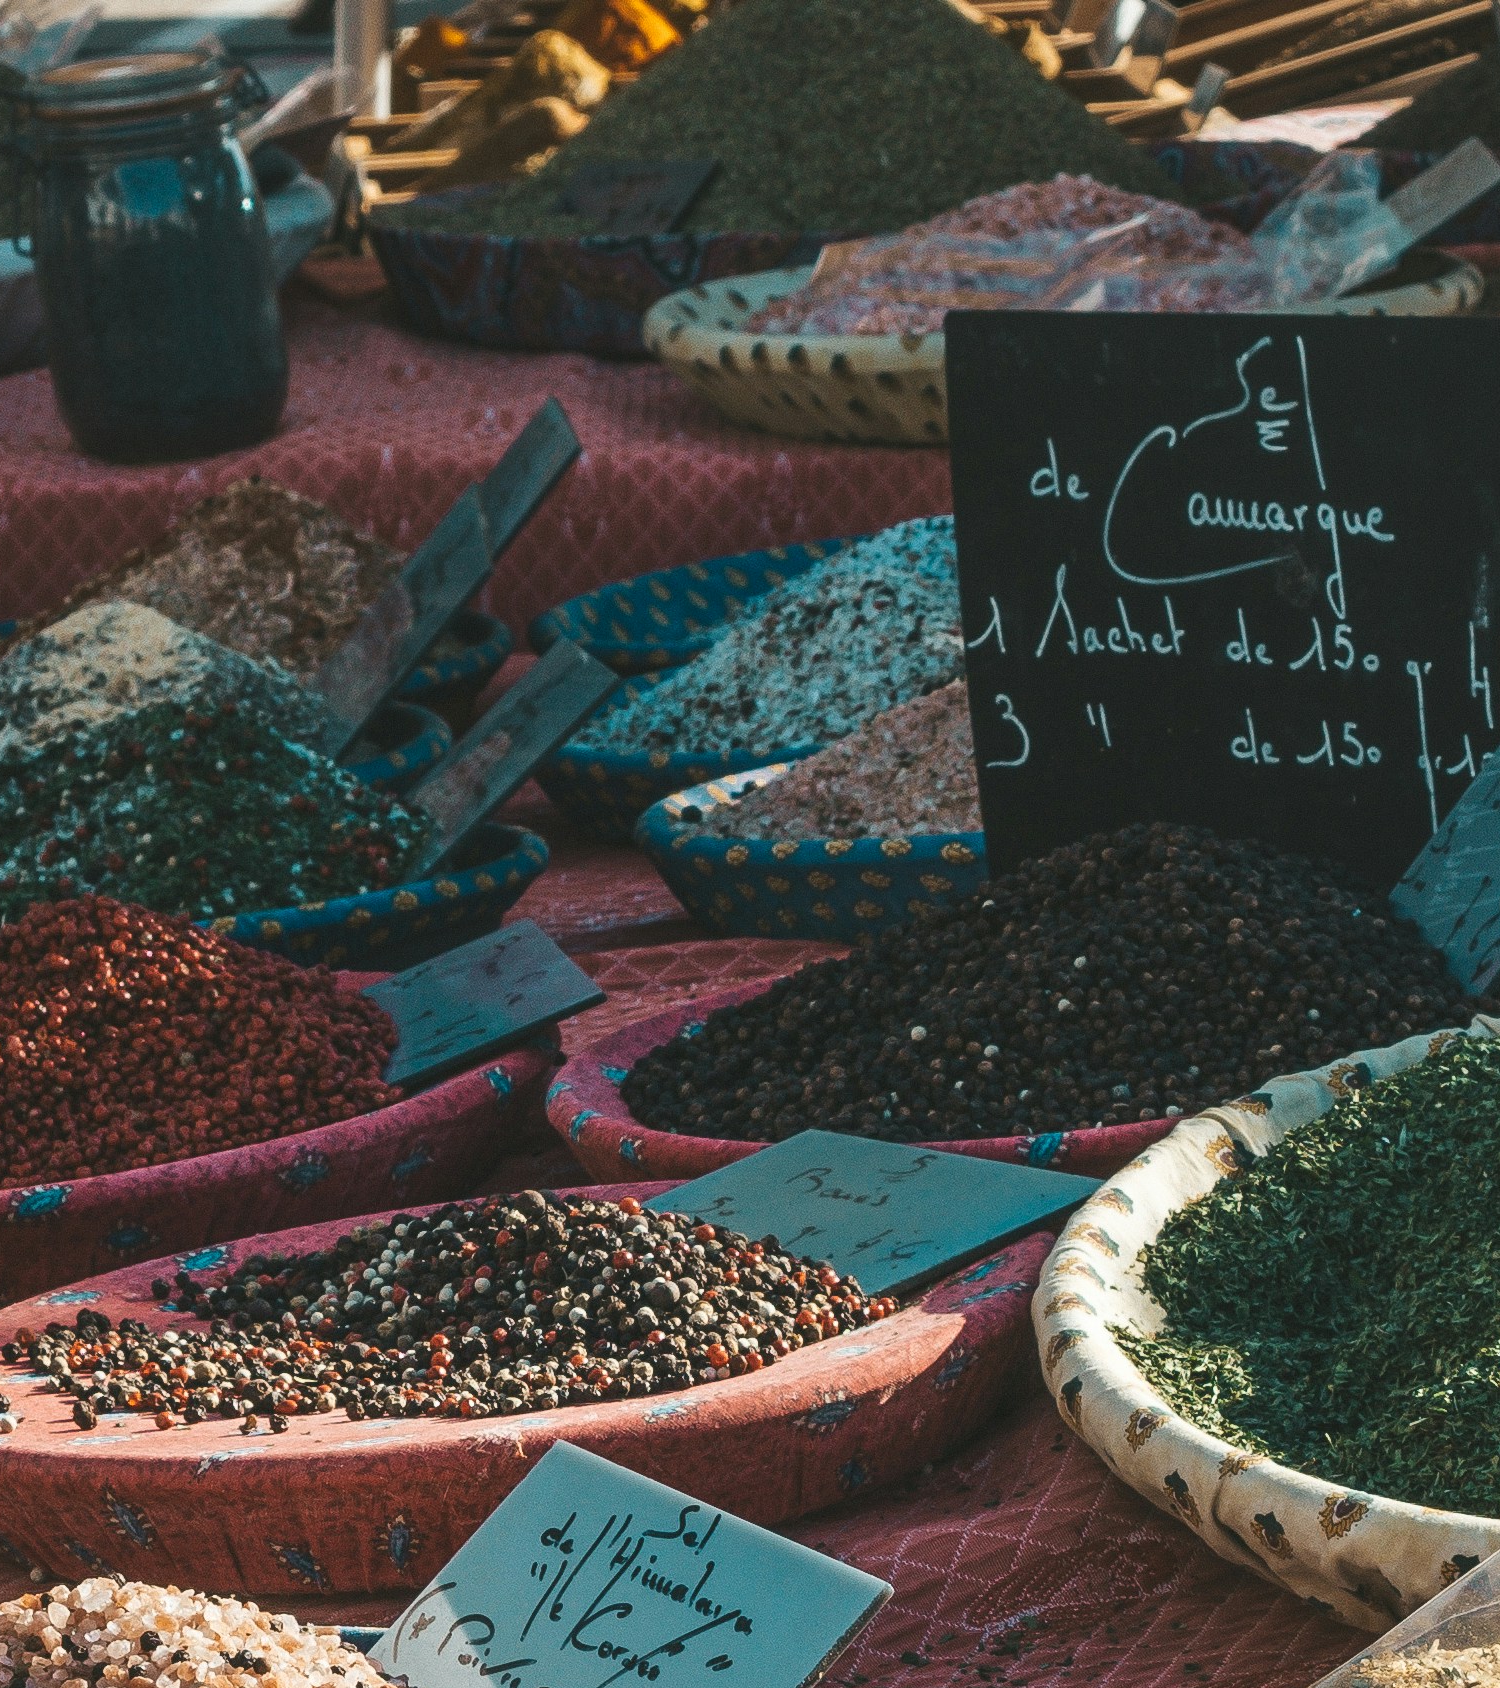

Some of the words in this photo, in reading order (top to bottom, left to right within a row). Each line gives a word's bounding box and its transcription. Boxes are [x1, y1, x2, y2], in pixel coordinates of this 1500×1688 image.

[1182, 335, 1326, 490] Sel
[1030, 438, 1090, 500] de
[967, 598, 1005, 652] 1
[1225, 608, 1273, 664] de
[1290, 617, 1380, 671] 150
[987, 694, 1030, 767] 3
[1232, 708, 1280, 764] de
[1297, 721, 1381, 766] 150
[541, 1512, 577, 1553] de
[642, 1504, 721, 1555] Sel
